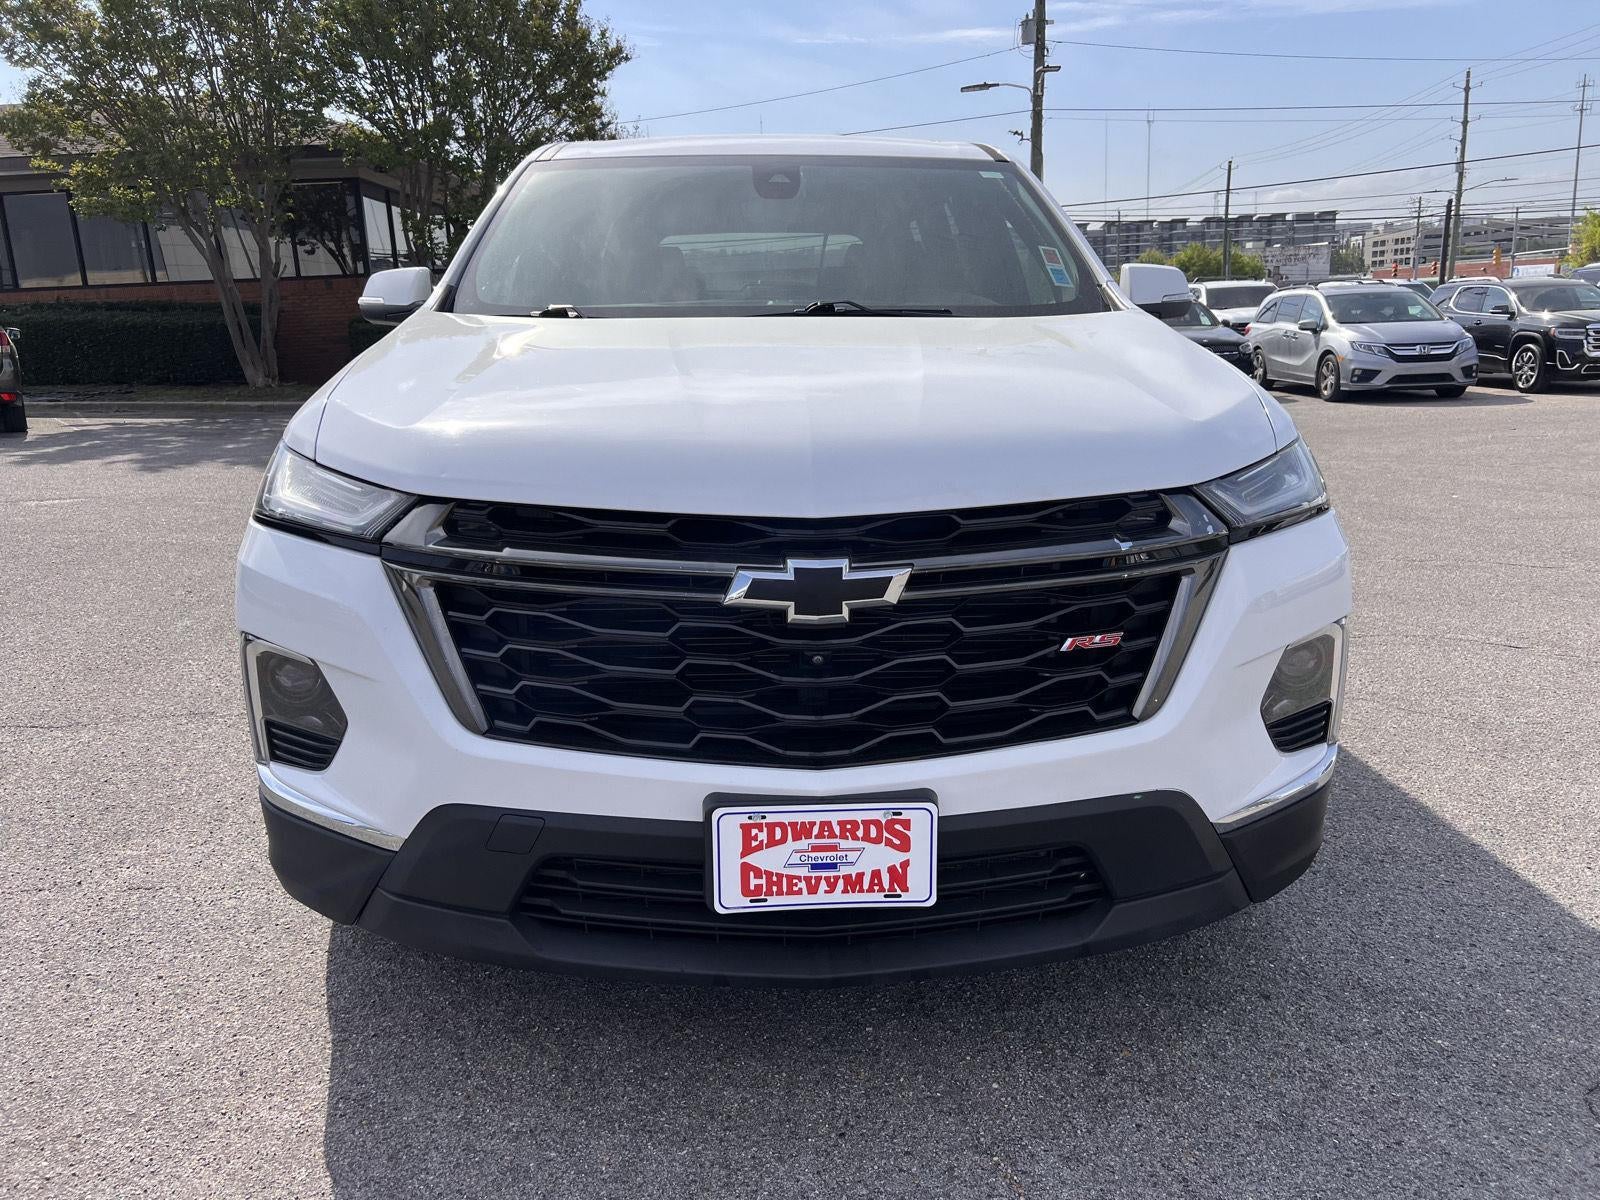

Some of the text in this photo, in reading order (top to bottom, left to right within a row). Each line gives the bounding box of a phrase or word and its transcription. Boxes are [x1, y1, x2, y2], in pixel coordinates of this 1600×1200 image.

[1060, 632, 1124, 651] RS
[739, 818, 911, 859] EDWARDS
[799, 853, 849, 863] Chevrolet
[739, 858, 911, 898] CHEVYMAN
